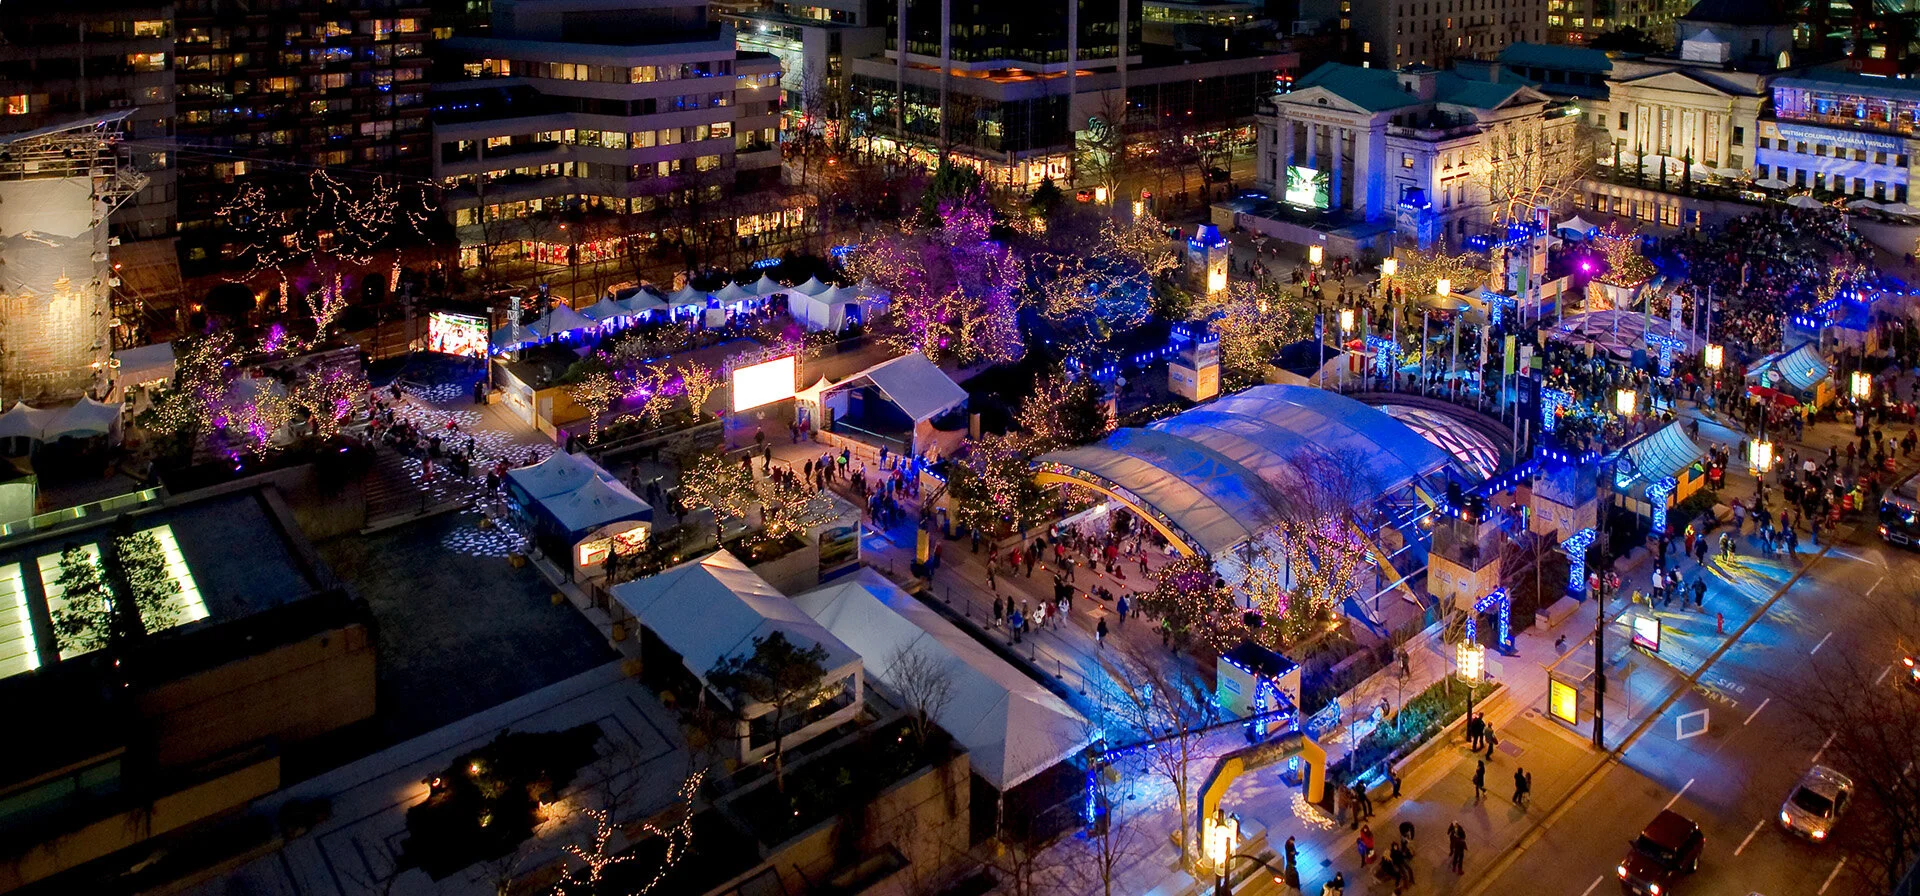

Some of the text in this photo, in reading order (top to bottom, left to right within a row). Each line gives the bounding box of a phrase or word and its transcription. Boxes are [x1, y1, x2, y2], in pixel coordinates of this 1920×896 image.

[1781, 129, 1895, 149] BRITISH COLUMBIA CANADA PAVILION
[1717, 678, 1746, 694] BUS
